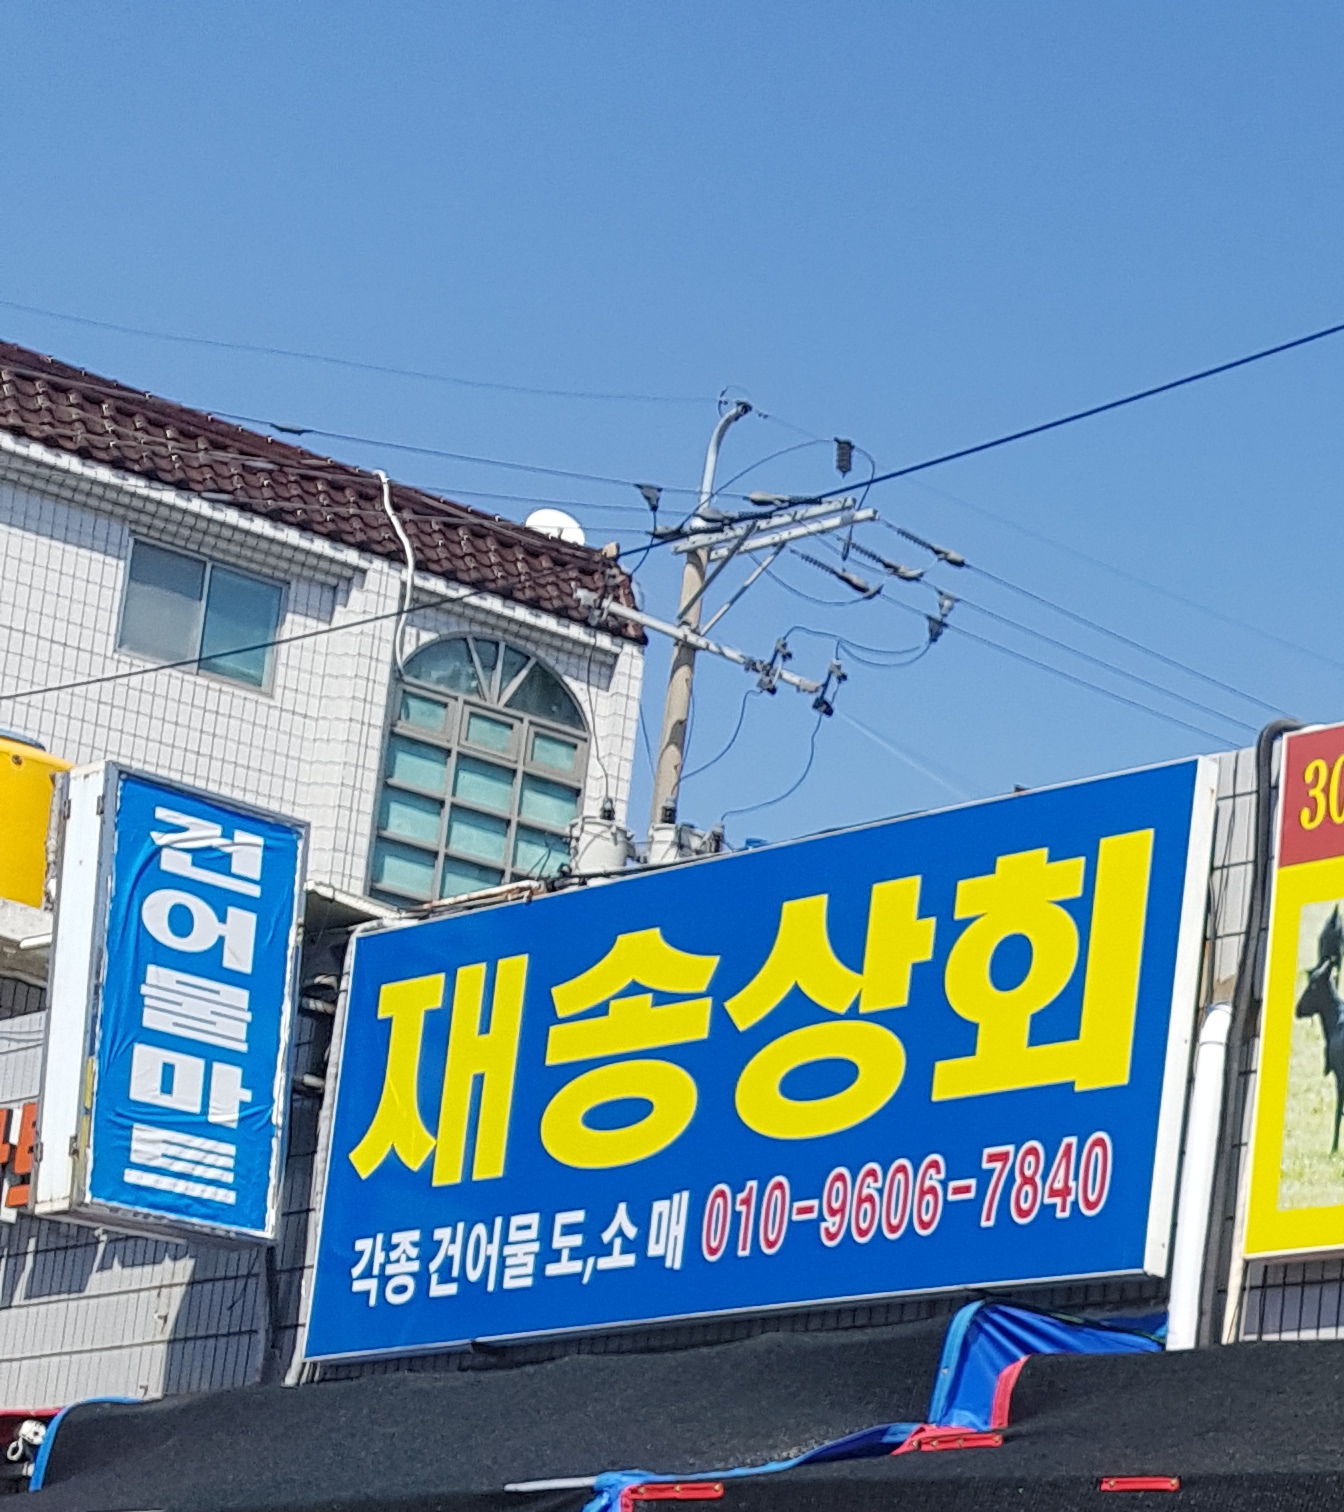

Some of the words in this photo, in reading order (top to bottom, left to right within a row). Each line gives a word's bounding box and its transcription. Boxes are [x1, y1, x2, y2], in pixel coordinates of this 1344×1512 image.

[349, 826, 1155, 1188] 재송상회
[350, 1229, 420, 1309] 각종
[427, 1210, 541, 1298] 건어물
[701, 1129, 1114, 1264] 010-9606-7840
